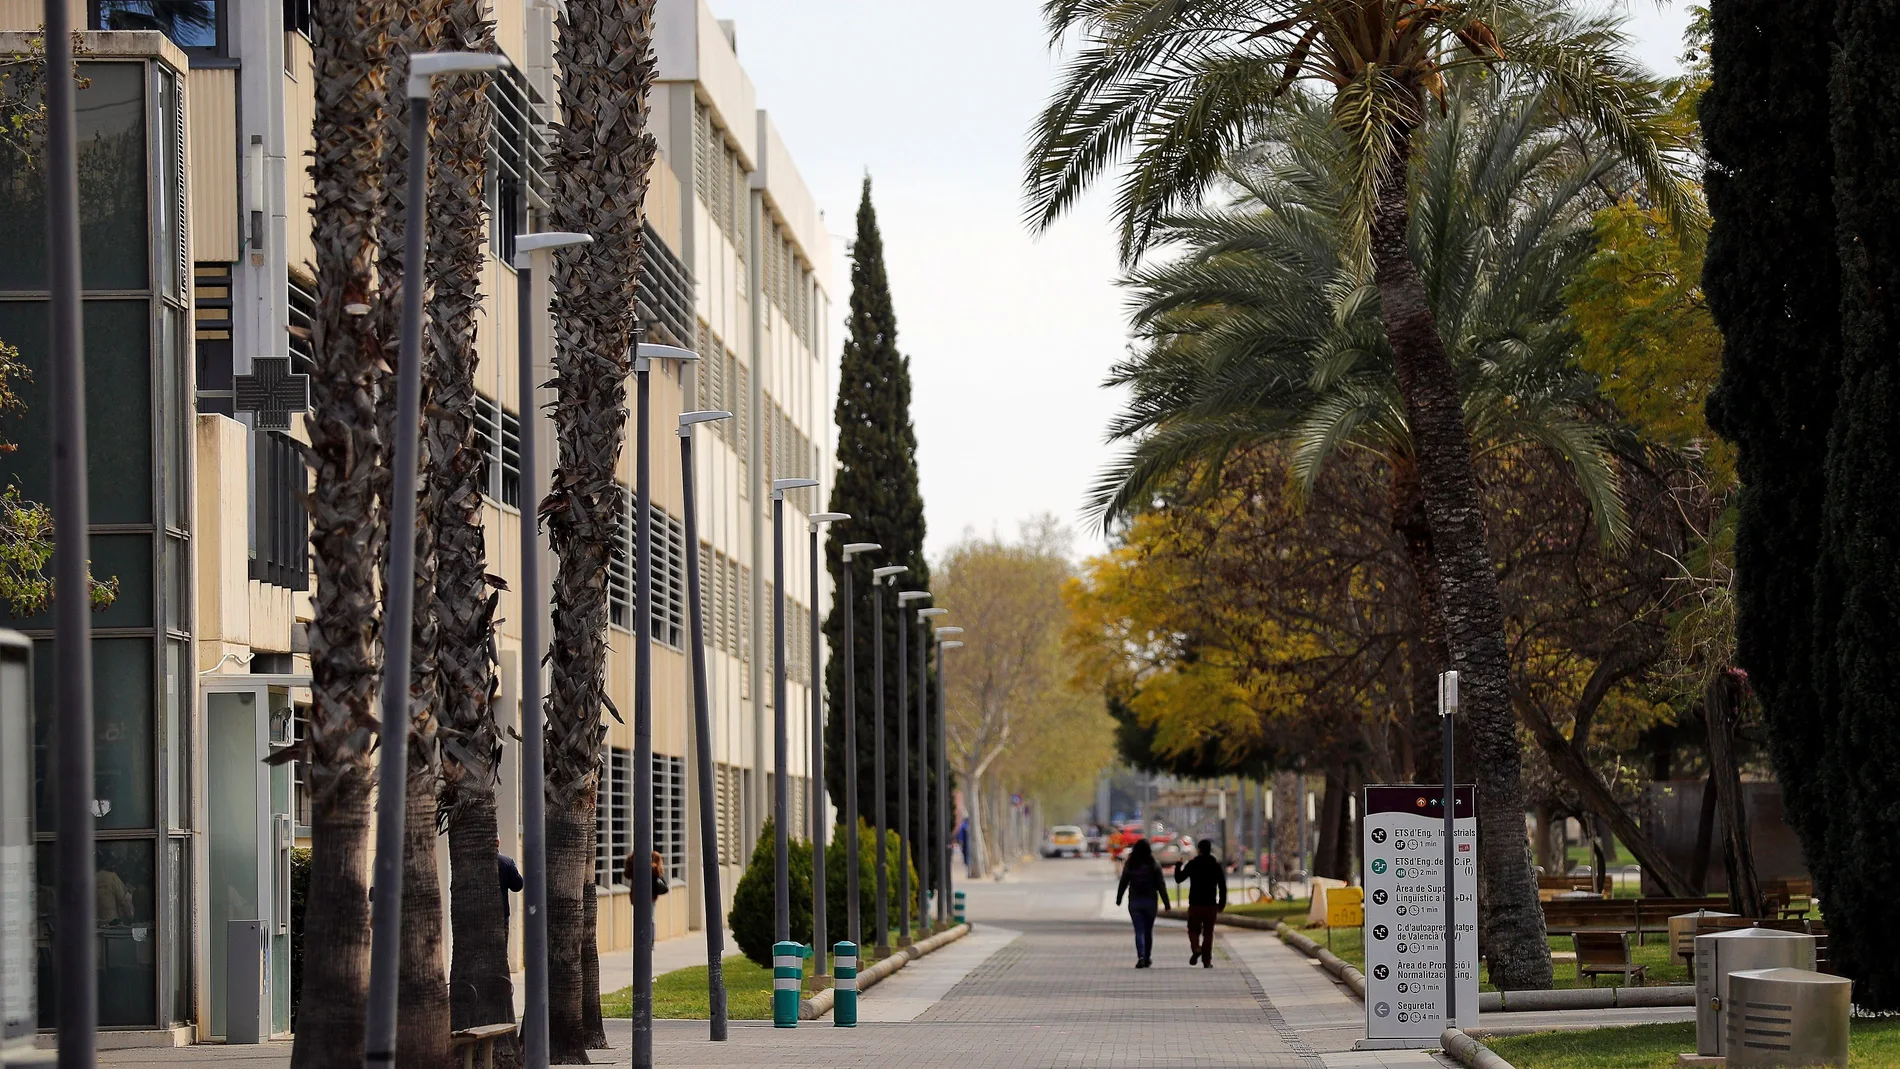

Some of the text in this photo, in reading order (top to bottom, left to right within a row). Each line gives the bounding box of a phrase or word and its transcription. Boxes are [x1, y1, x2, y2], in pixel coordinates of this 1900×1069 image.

[1439, 829, 1476, 837] Instrials
[1434, 858, 1444, 866] de
[1416, 885, 1425, 893] de
[1397, 933, 1406, 941] de
[1408, 932, 1439, 941] Valencià
[1417, 961, 1427, 969] de
[1397, 970, 1446, 979] Normalitzaci
[1397, 1001, 1435, 1011] Seguretat
